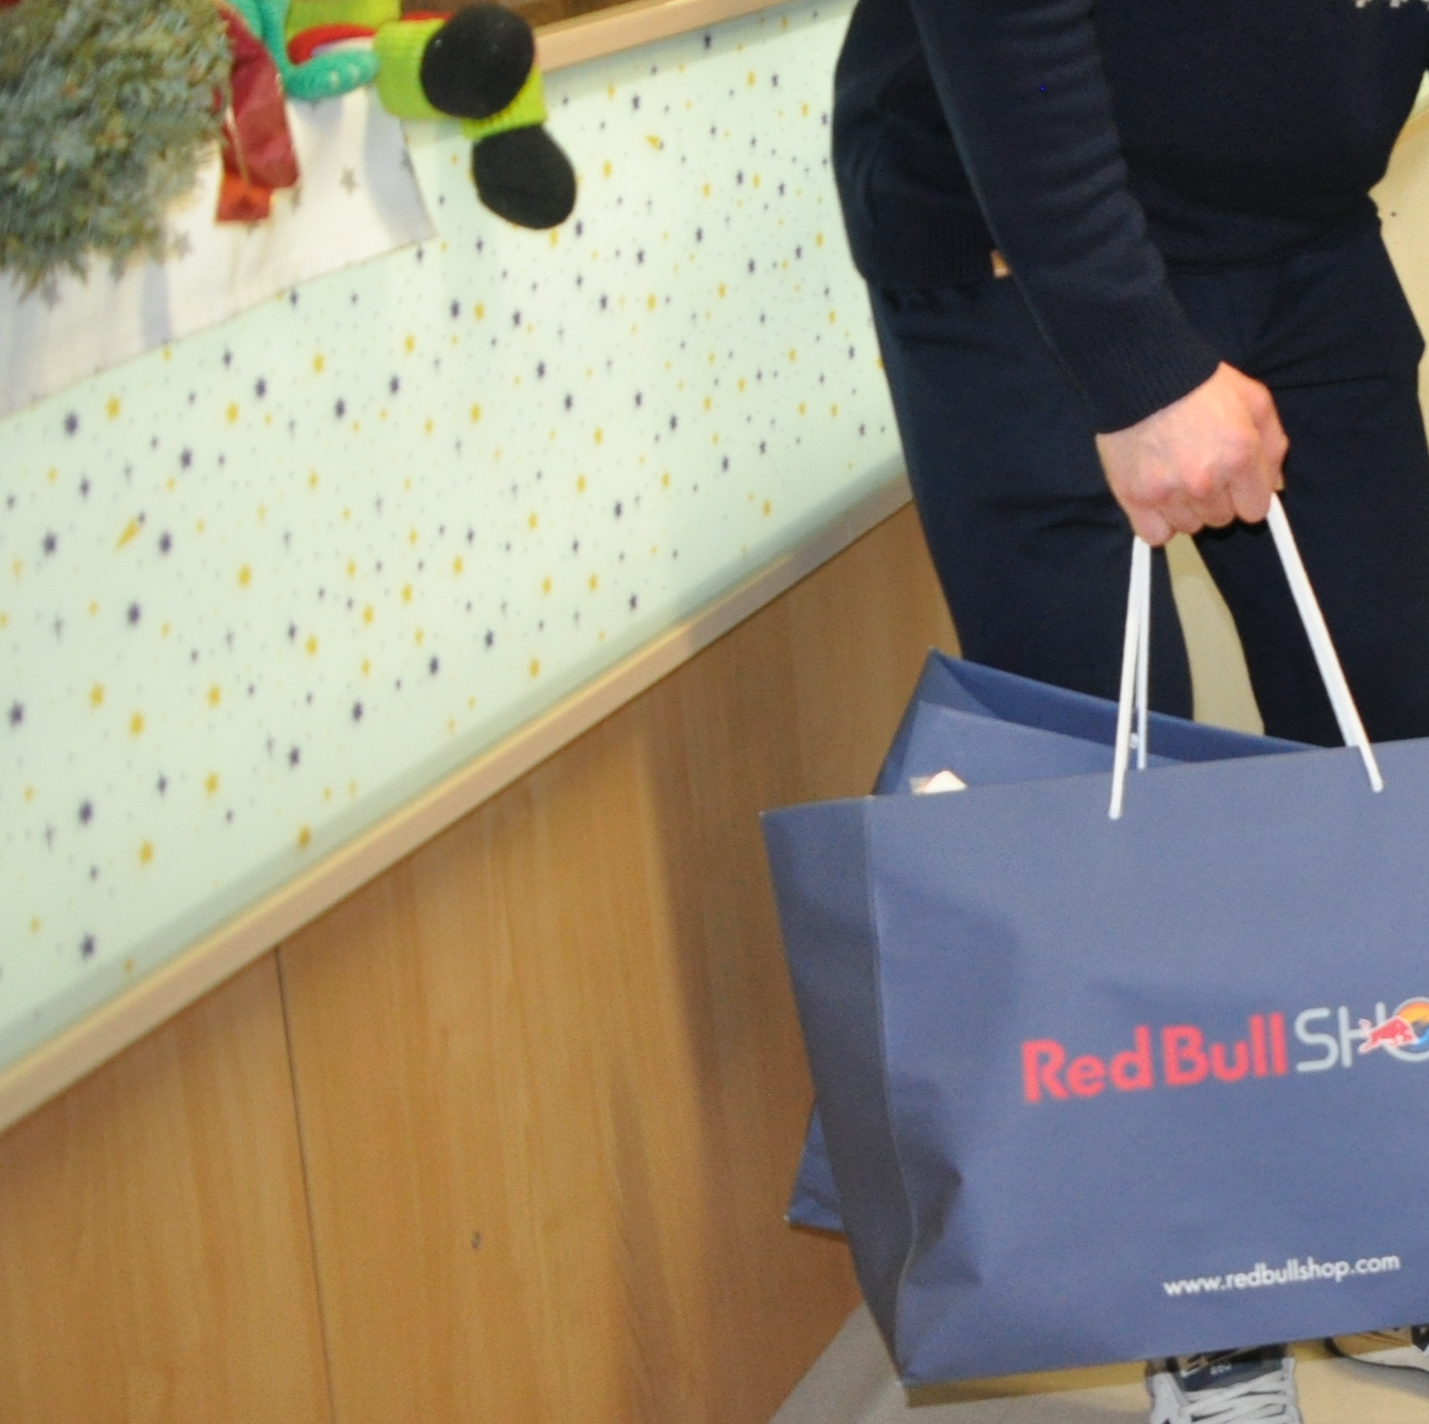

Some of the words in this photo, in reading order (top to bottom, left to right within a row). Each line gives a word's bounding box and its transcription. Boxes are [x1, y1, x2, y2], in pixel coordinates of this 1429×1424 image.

[1021, 1024, 1154, 1104] Red
[1161, 1012, 1289, 1087] Bull
[1163, 1254, 1402, 1298] www.redbullshop.com
